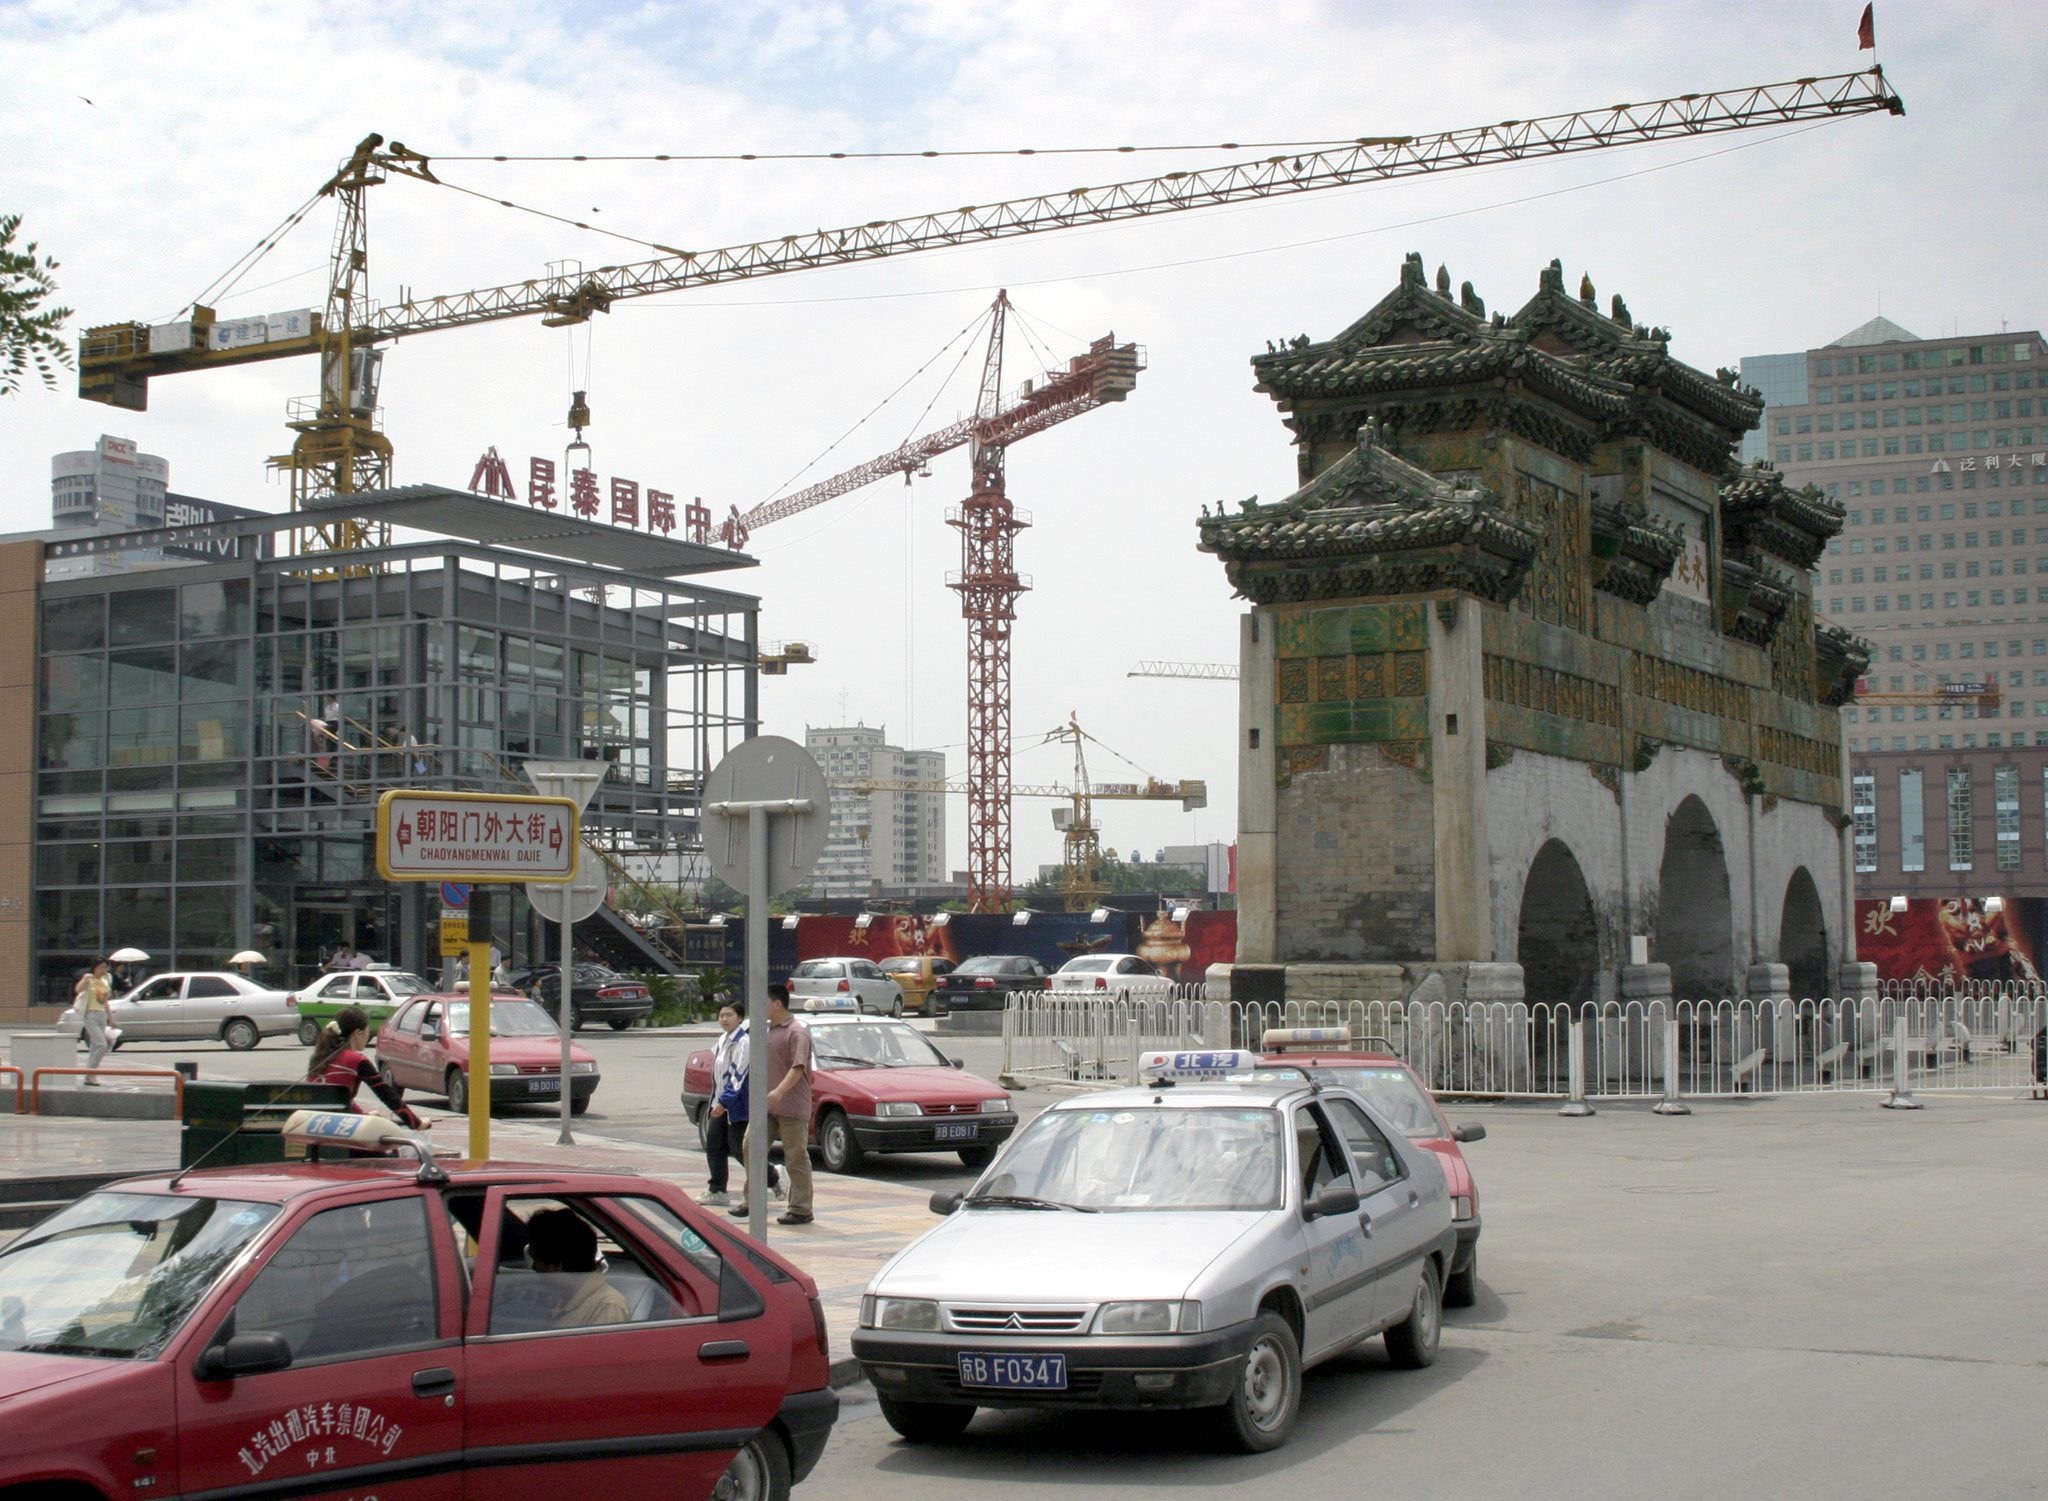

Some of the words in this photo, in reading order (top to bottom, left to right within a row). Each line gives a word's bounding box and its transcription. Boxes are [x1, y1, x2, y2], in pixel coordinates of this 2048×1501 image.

[1960, 453, 2047, 472] 泛利大厦
[529, 456, 750, 550] 昆泰国际中心
[416, 809, 546, 845] 朝阳门外大街
[420, 847, 510, 861] CHAOYANGMENWAI
[517, 849, 541, 862] DAJIE
[1864, 901, 1898, 937] 欢
[1180, 1053, 1233, 1068] 北汽
[309, 1115, 356, 1136] 北汽
[238, 1402, 402, 1476] 北汽出租汽车集团公司
[306, 1447, 336, 1467] 中北
